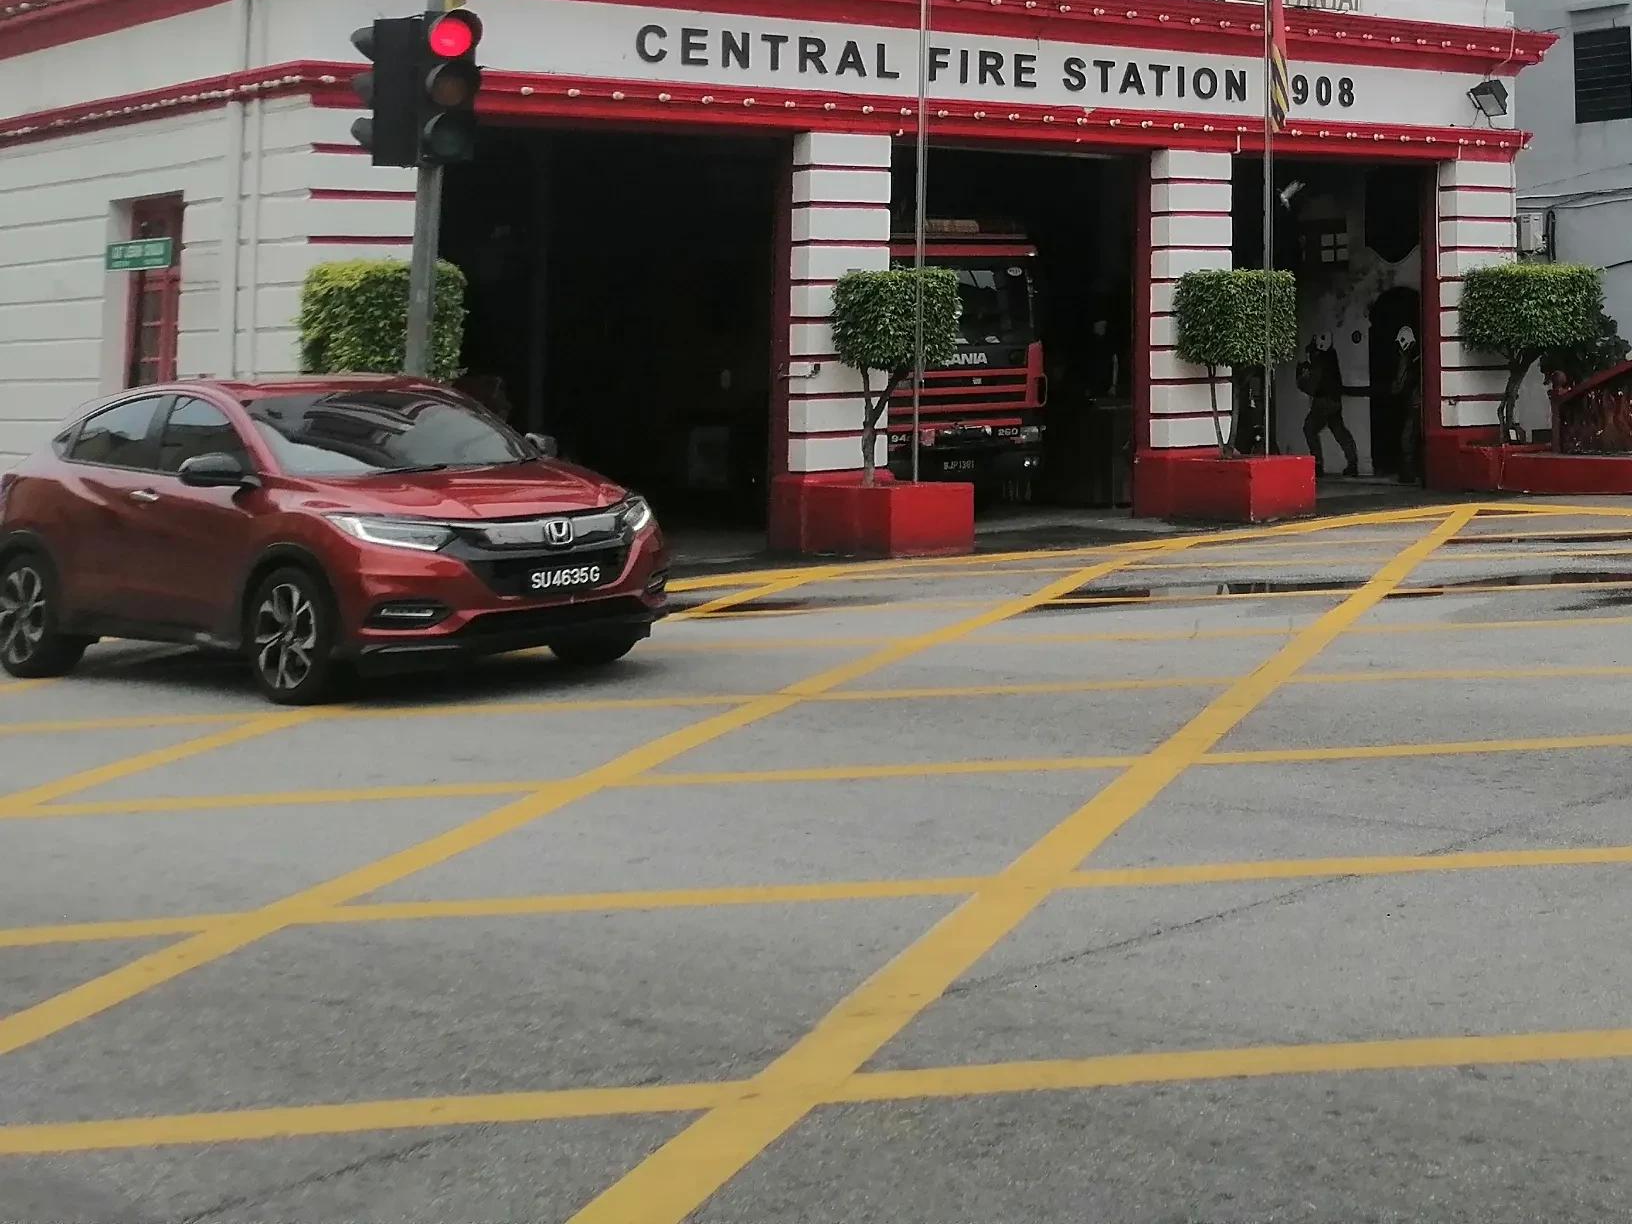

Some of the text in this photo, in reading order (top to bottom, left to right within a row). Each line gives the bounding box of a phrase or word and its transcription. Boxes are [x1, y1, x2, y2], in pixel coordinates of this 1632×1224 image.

[635, 24, 1355, 108] CENTRAL FIRE STATION 908
[941, 352, 988, 368] ANIA
[531, 566, 600, 589] SU4635G
